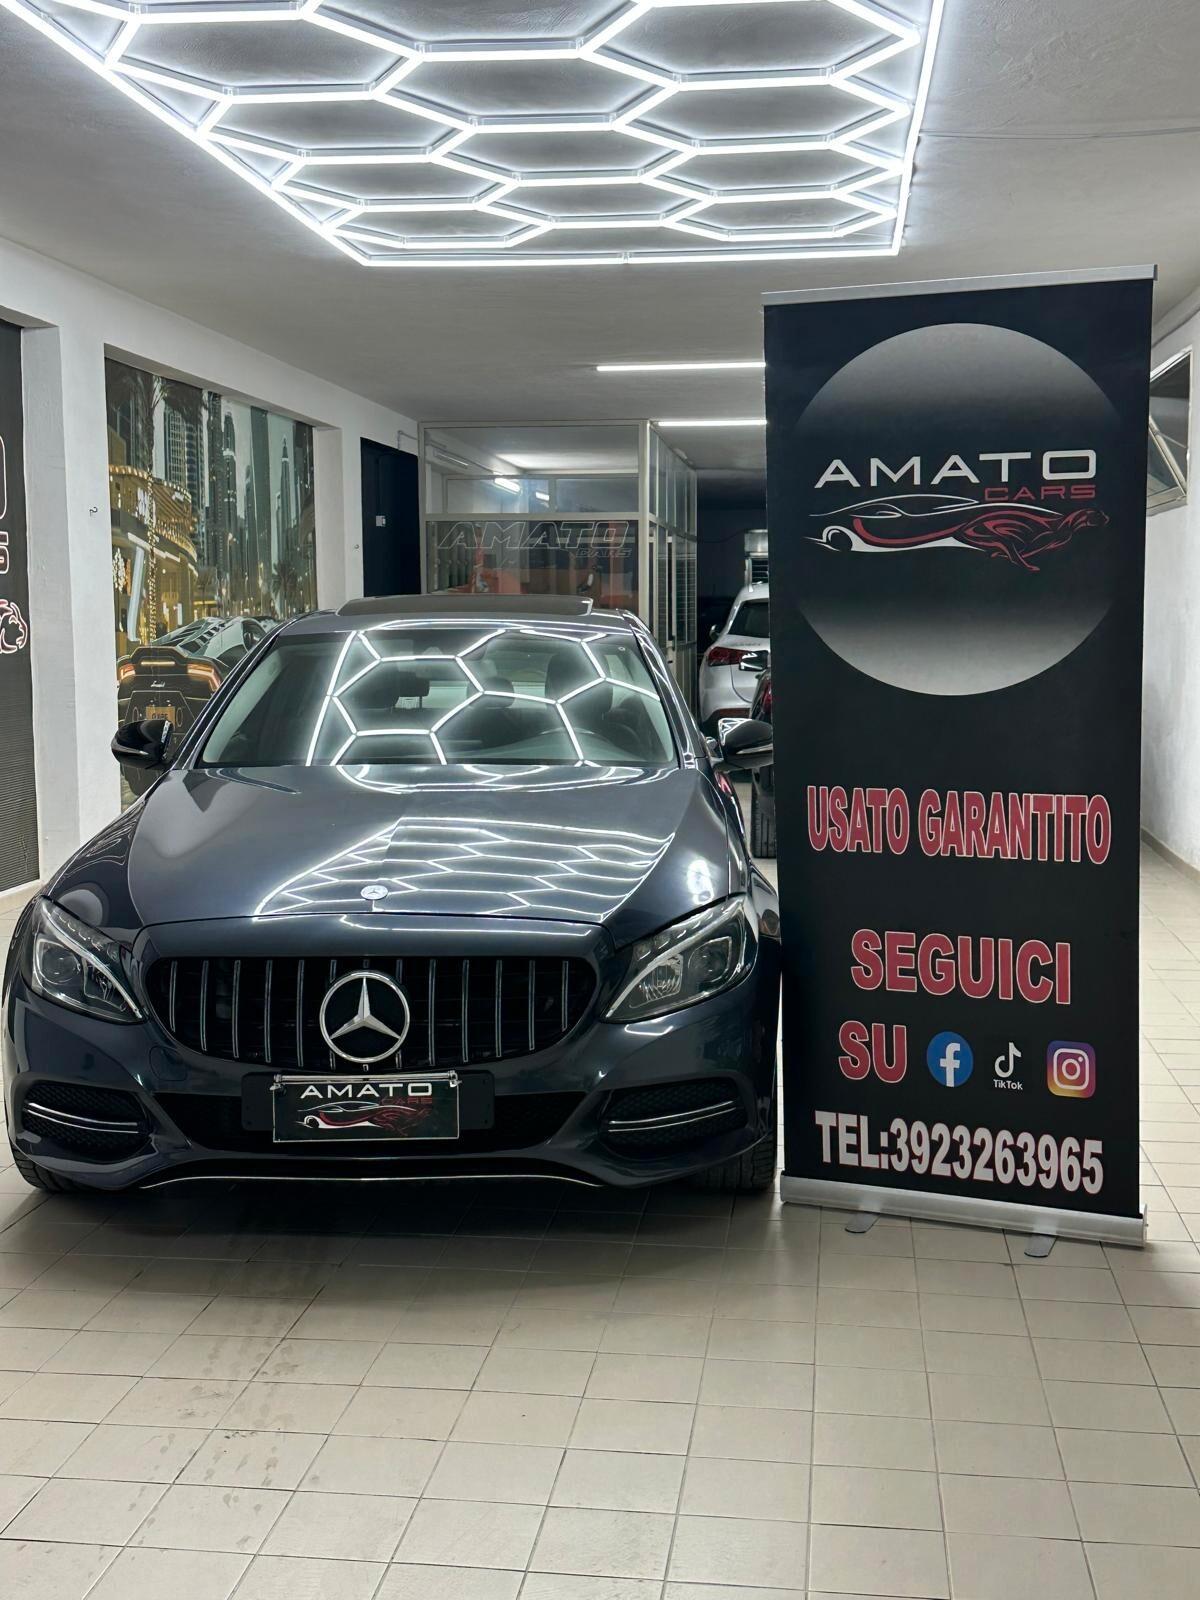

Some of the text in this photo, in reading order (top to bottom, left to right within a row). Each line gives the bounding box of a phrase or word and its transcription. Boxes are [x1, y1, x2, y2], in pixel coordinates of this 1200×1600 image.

[814, 449, 1097, 488] AMATO
[984, 484, 1097, 501] CARS
[438, 521, 630, 549] AMATO
[807, 785, 1112, 865] USATO GARANTITO
[851, 929, 1071, 1005] SEGUICI
[838, 1020, 908, 1084] SU
[300, 1083, 432, 1099] AMATO
[993, 1078, 1024, 1091] TikTok
[815, 1110, 1104, 1195] TEL:3923263965
